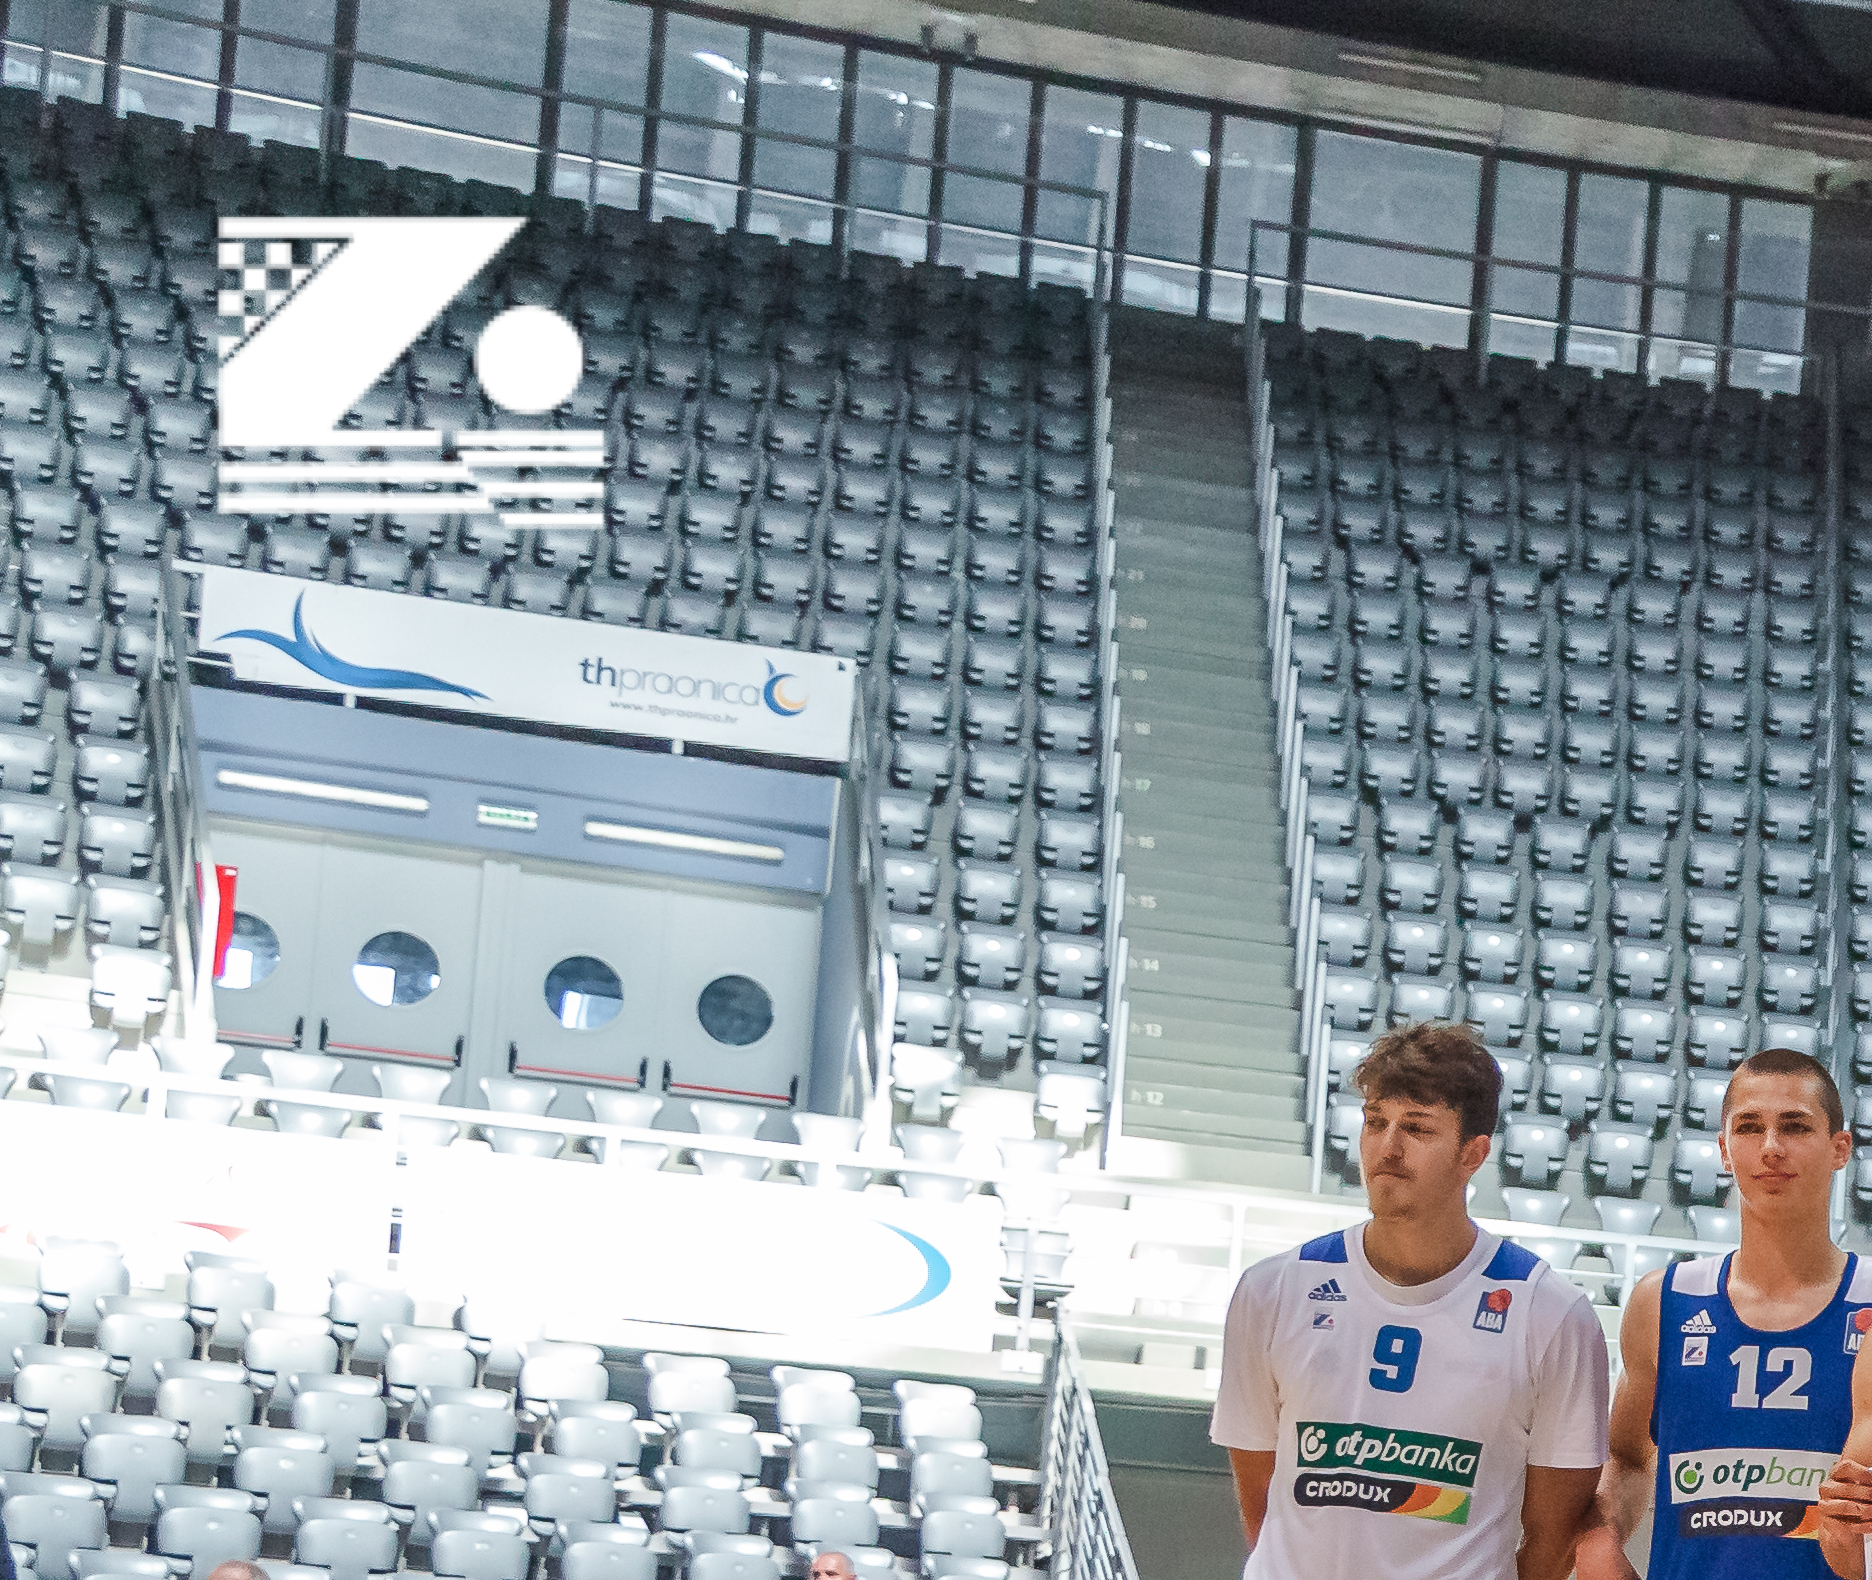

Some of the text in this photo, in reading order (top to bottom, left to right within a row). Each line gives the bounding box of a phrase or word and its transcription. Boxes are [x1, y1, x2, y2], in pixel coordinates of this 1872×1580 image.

[579, 656, 761, 706] thpraonica
[1475, 1310, 1503, 1331] ABA
[1368, 1324, 1423, 1394] 9
[1728, 1345, 1813, 1411] 12
[1335, 1429, 1478, 1476] otpbanka
[1305, 1480, 1392, 1504] CRODUX
[1712, 1456, 1832, 1492] otpban
[1690, 1509, 1784, 1529] CRODUX
